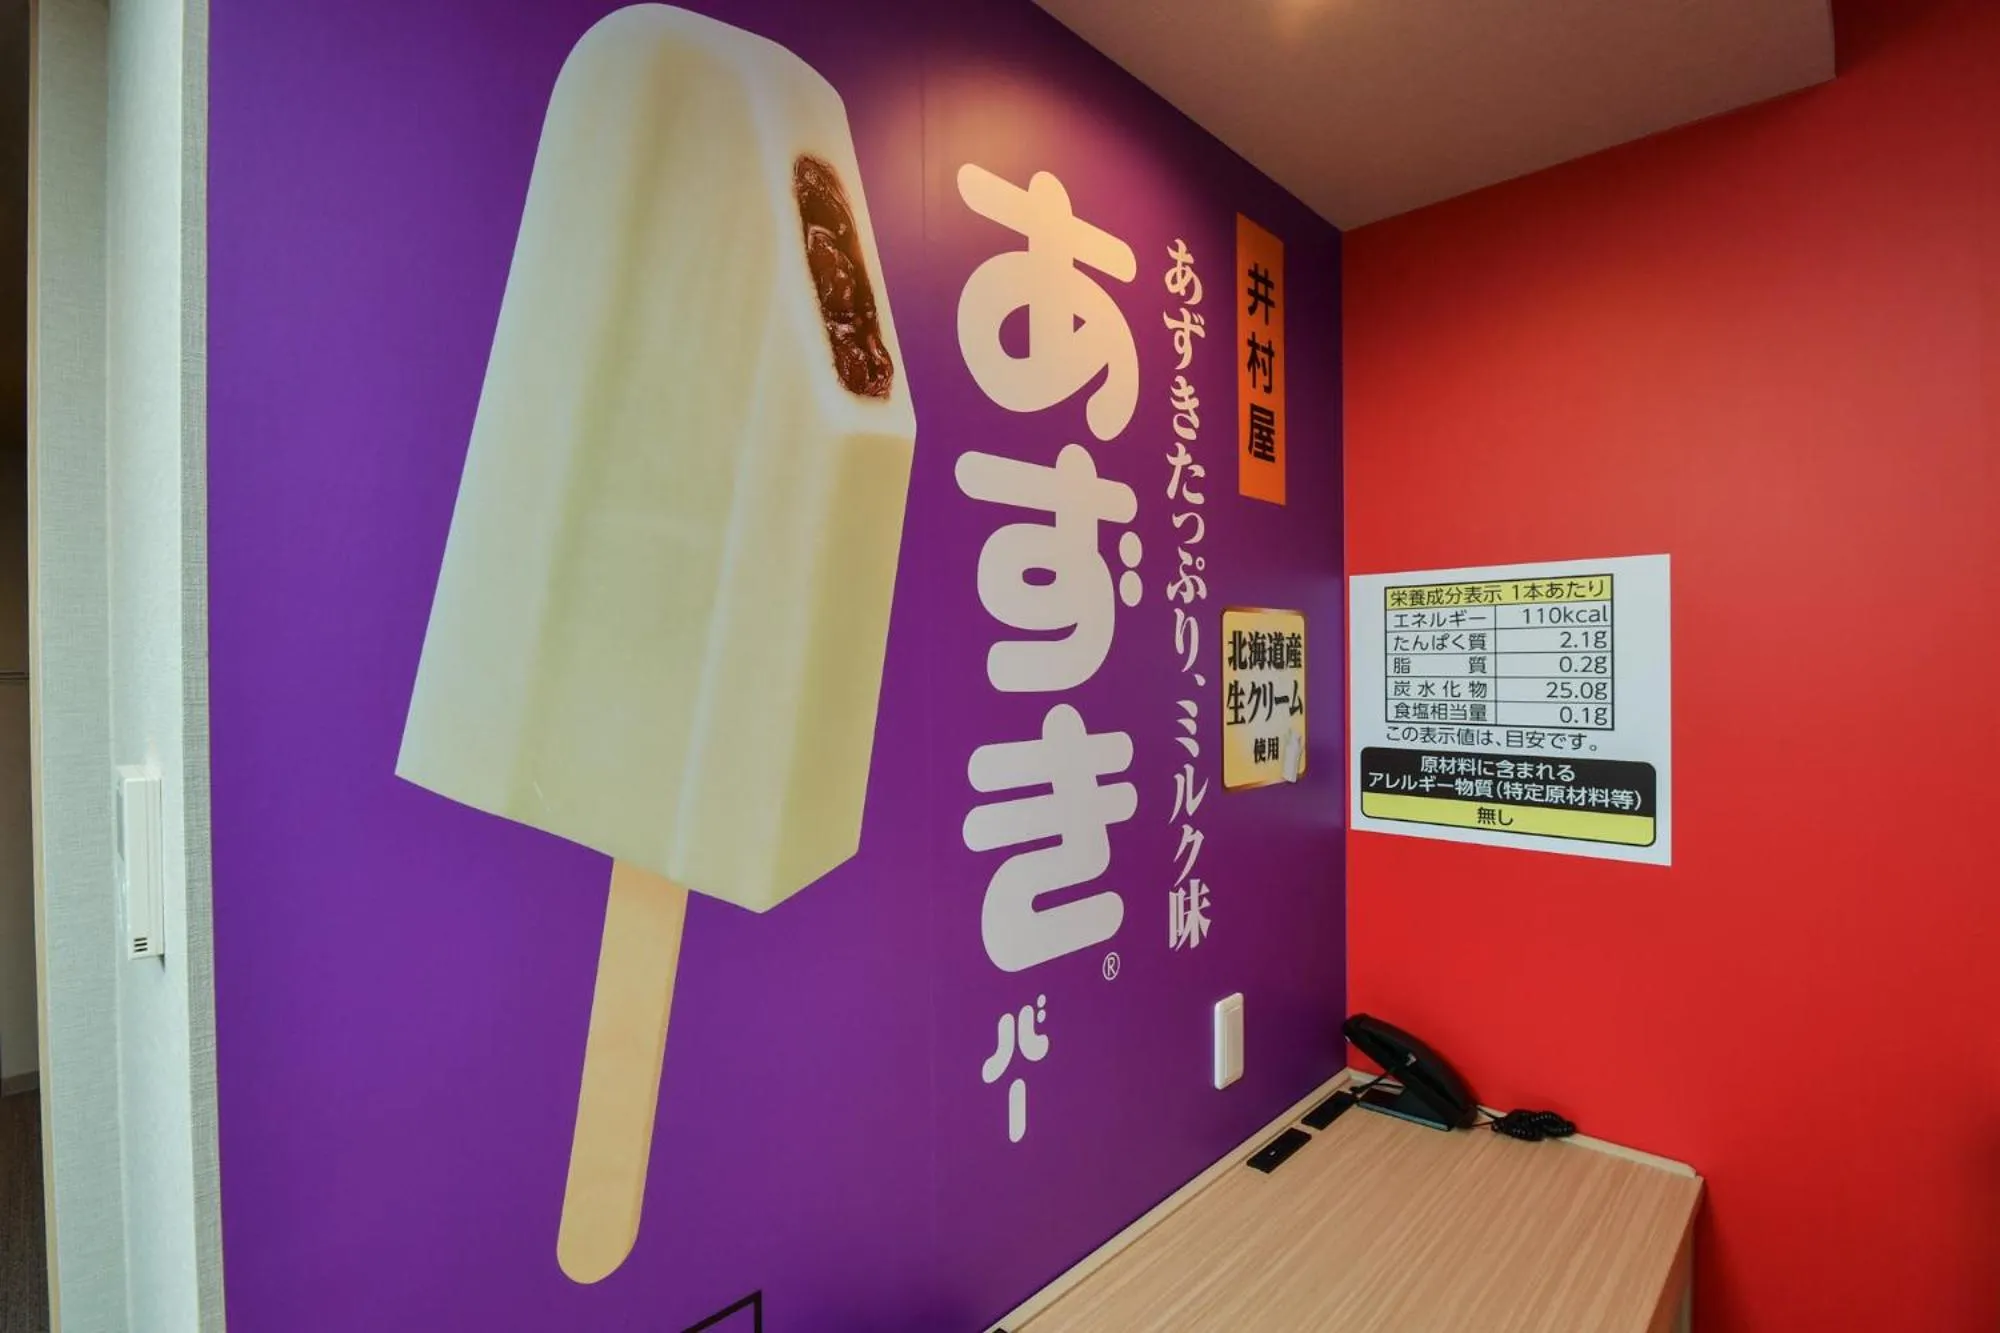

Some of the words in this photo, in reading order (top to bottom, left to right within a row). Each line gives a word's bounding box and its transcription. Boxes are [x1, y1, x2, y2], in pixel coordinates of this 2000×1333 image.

[1247, 263, 1276, 463] 井村屋
[955, 163, 1143, 972] あずき
[1163, 238, 1211, 952] あずきたっぷり、ミルク味
[1390, 585, 1502, 606] 栄養成分表示
[1511, 580, 1604, 600] 1本あたり
[1393, 609, 1487, 629] エネルギー
[1522, 605, 1608, 625] 110kcal
[1227, 629, 1303, 671] 北海道産
[1393, 632, 1487, 652] たんぱく質
[1560, 631, 1608, 650] 2.1g
[1559, 655, 1608, 675] 0.2g
[1226, 679, 1304, 726] 生クリーム
[1546, 682, 1608, 701] 25.0g
[1394, 703, 1488, 722] 食塩相当量
[1560, 706, 1608, 726] 0.1g
[1253, 737, 1280, 764] 使用
[1420, 756, 1576, 782] 原材料に含まれる
[1477, 807, 1514, 826] 無し
[982, 994, 1049, 1142] バー
